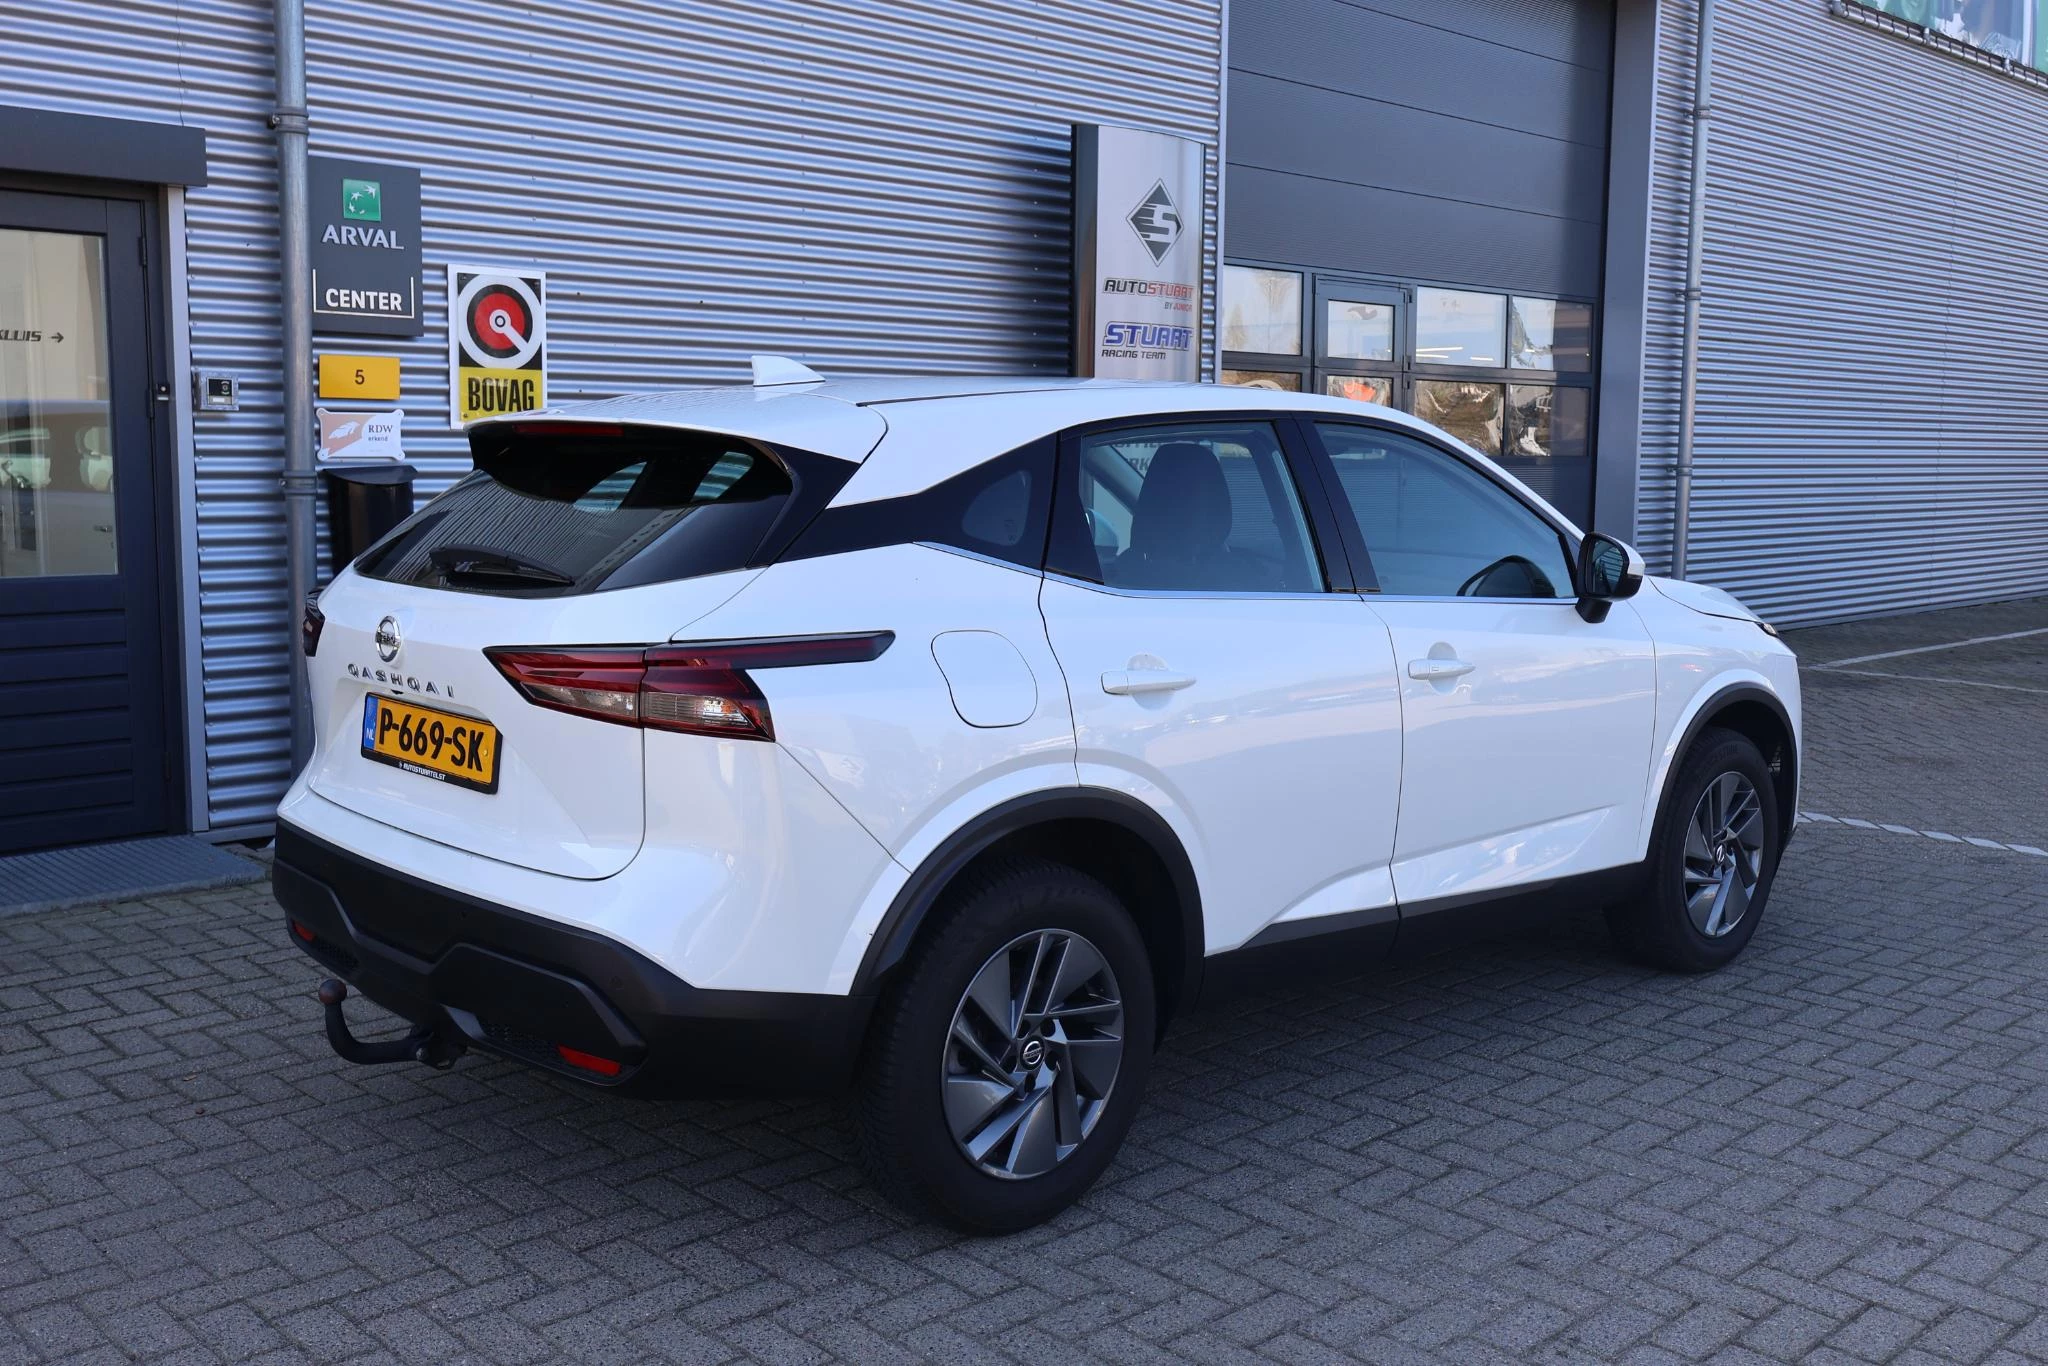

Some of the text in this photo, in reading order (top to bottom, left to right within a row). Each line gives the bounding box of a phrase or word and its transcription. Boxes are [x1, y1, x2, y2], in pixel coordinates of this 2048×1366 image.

[322, 224, 405, 250] ARVAL
[325, 288, 402, 311] CENTER
[1104, 279, 1194, 298] AUTOSTUART
[1105, 324, 1193, 349] STUART
[1101, 349, 1167, 360] RACING TEAM
[354, 369, 365, 385] 5
[468, 377, 535, 413] BOVAG
[368, 424, 393, 433] RDW
[347, 663, 455, 698] QASHQAI
[365, 707, 485, 773] NL P-669-SK
